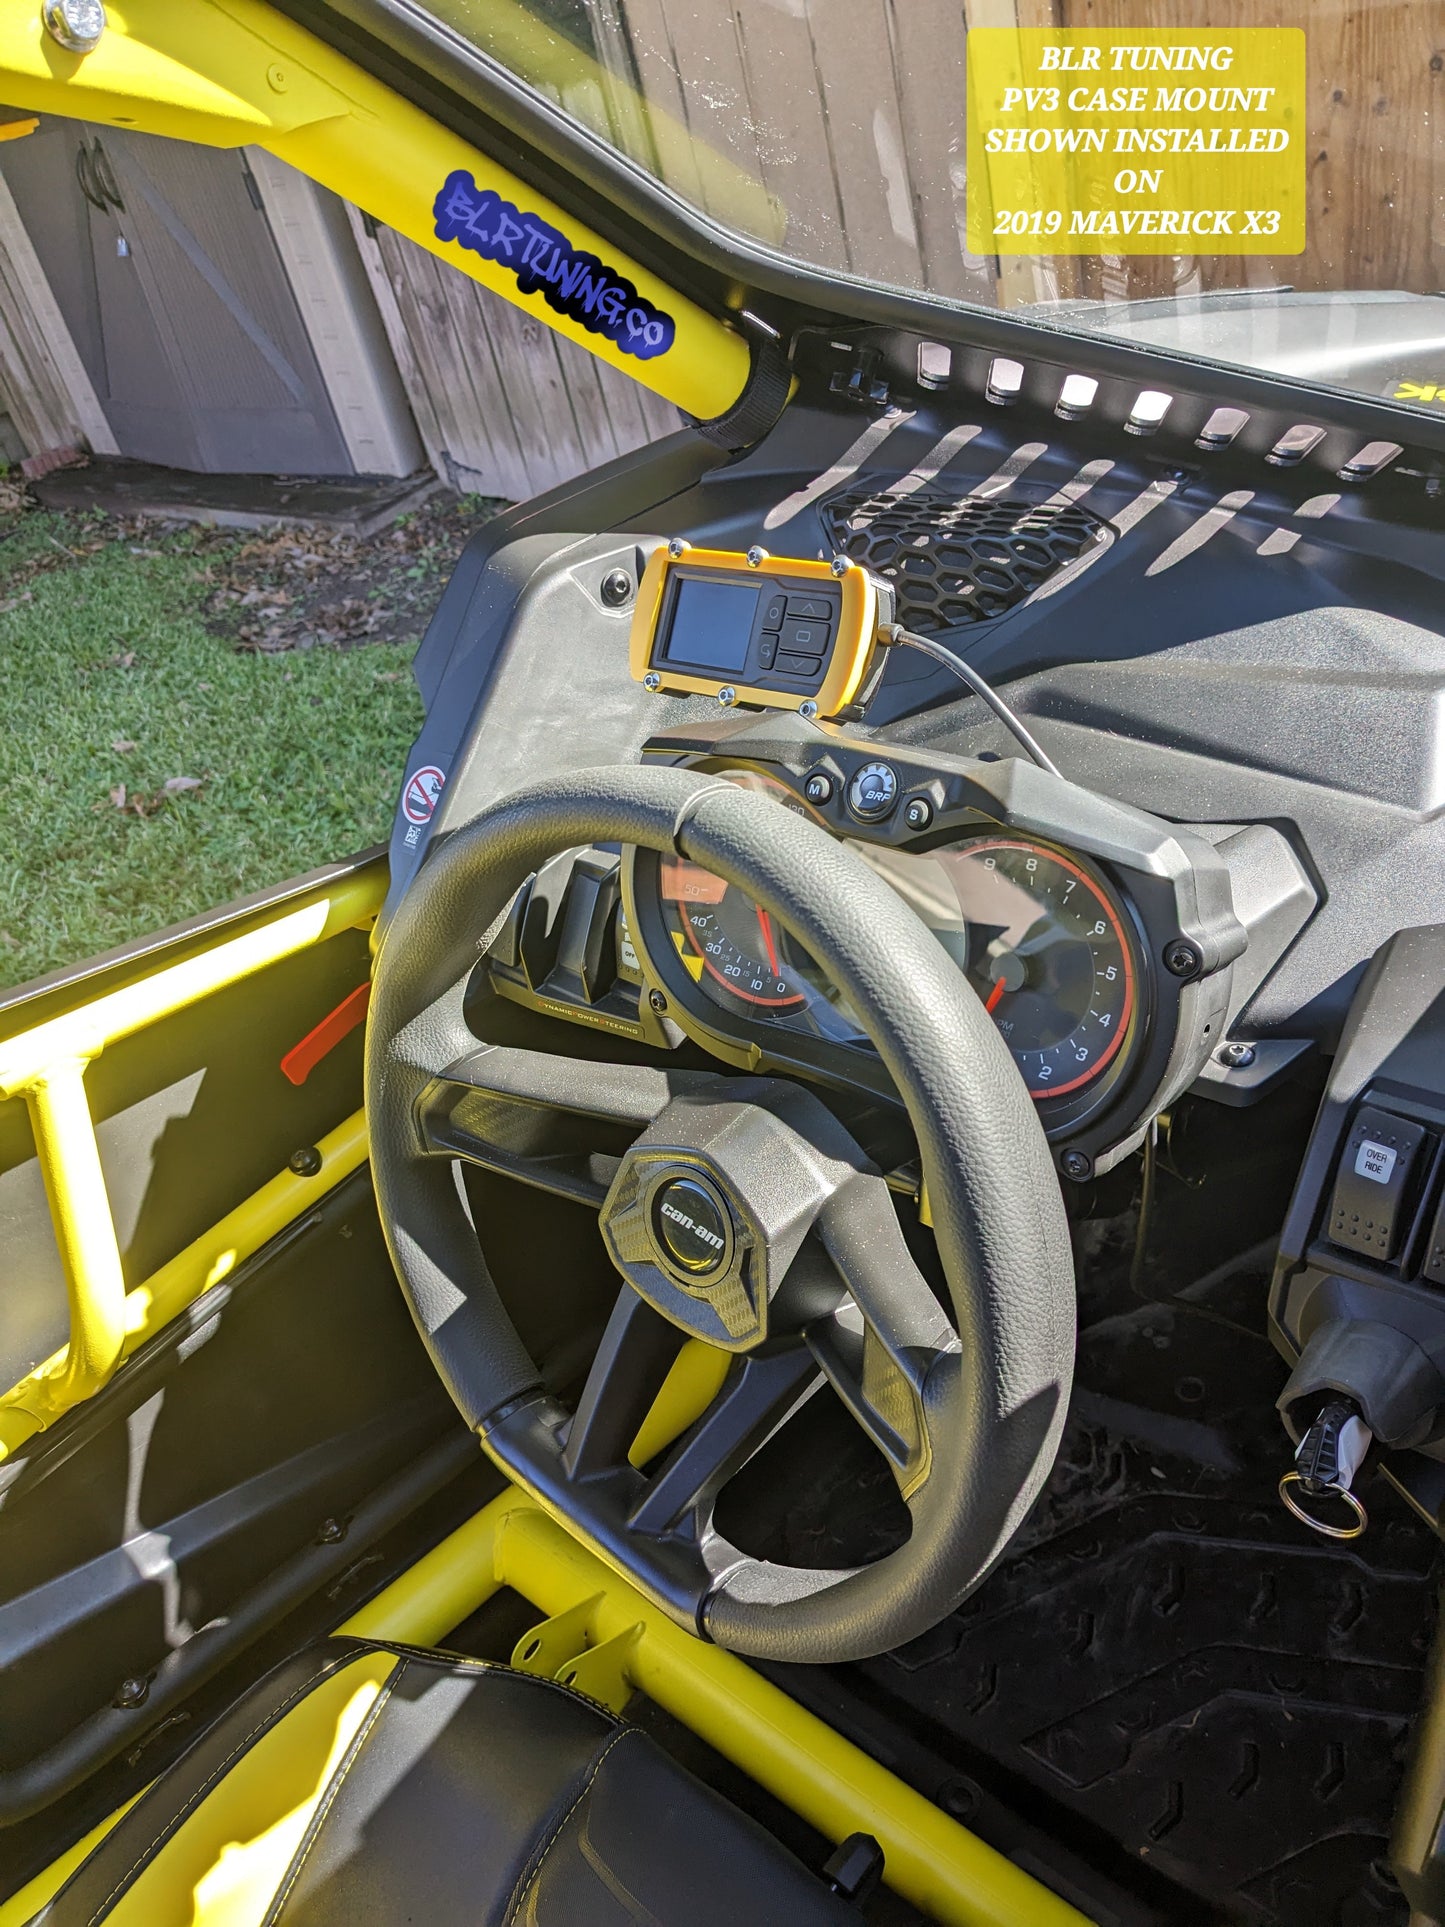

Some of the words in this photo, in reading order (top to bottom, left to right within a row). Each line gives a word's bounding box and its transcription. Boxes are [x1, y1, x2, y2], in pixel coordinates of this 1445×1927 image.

[808, 784, 820, 795] M
[865, 790, 891, 802] BRP
[909, 809, 918, 820] S
[984, 858, 996, 871] 9
[1026, 858, 1037, 871] 8
[684, 884, 700, 896] 50
[1065, 880, 1076, 893] 7
[690, 915, 707, 927] 40
[1095, 920, 1106, 935] 6
[706, 943, 722, 955] 30
[724, 964, 741, 977] 20
[1105, 967, 1117, 981] 5
[751, 979, 762, 991] 10
[777, 982, 786, 993] 0
[1099, 1013, 1110, 1027] 4
[1075, 1048, 1088, 1061] 3
[1039, 1066, 1052, 1080] 2
[1366, 1149, 1387, 1162] OVER
[1364, 1160, 1383, 1174] RIDE
[661, 1202, 724, 1250] can-am
